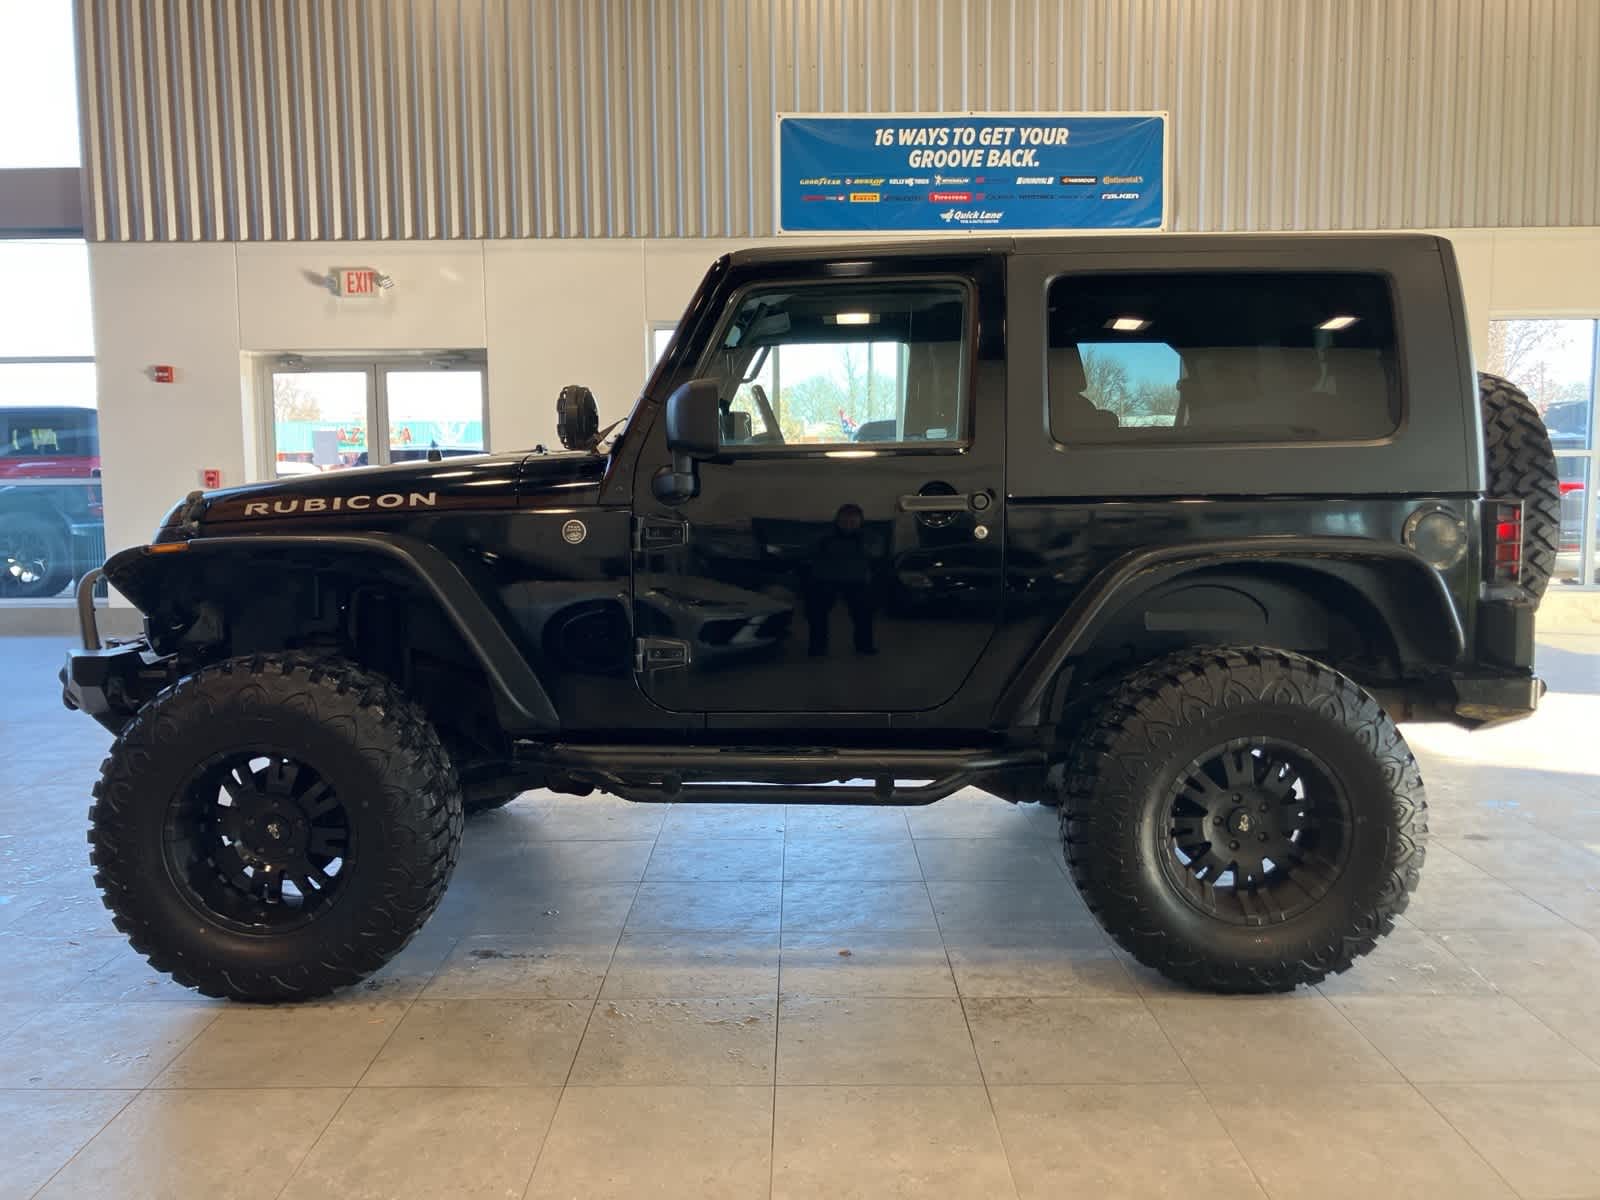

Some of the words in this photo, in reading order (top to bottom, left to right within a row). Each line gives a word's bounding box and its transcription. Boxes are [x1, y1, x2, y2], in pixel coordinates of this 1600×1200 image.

[874, 128, 894, 146] 16
[897, 127, 950, 146] WAYS
[952, 127, 976, 145] TO
[979, 127, 1015, 145] GET
[1019, 127, 1070, 145] YOUR
[908, 149, 984, 168] GROOVE
[986, 148, 1040, 167] BACK.
[954, 210, 980, 220] Quick
[980, 210, 1004, 219] Lane
[346, 271, 374, 293] EXIT
[243, 492, 438, 516] RUBICON
